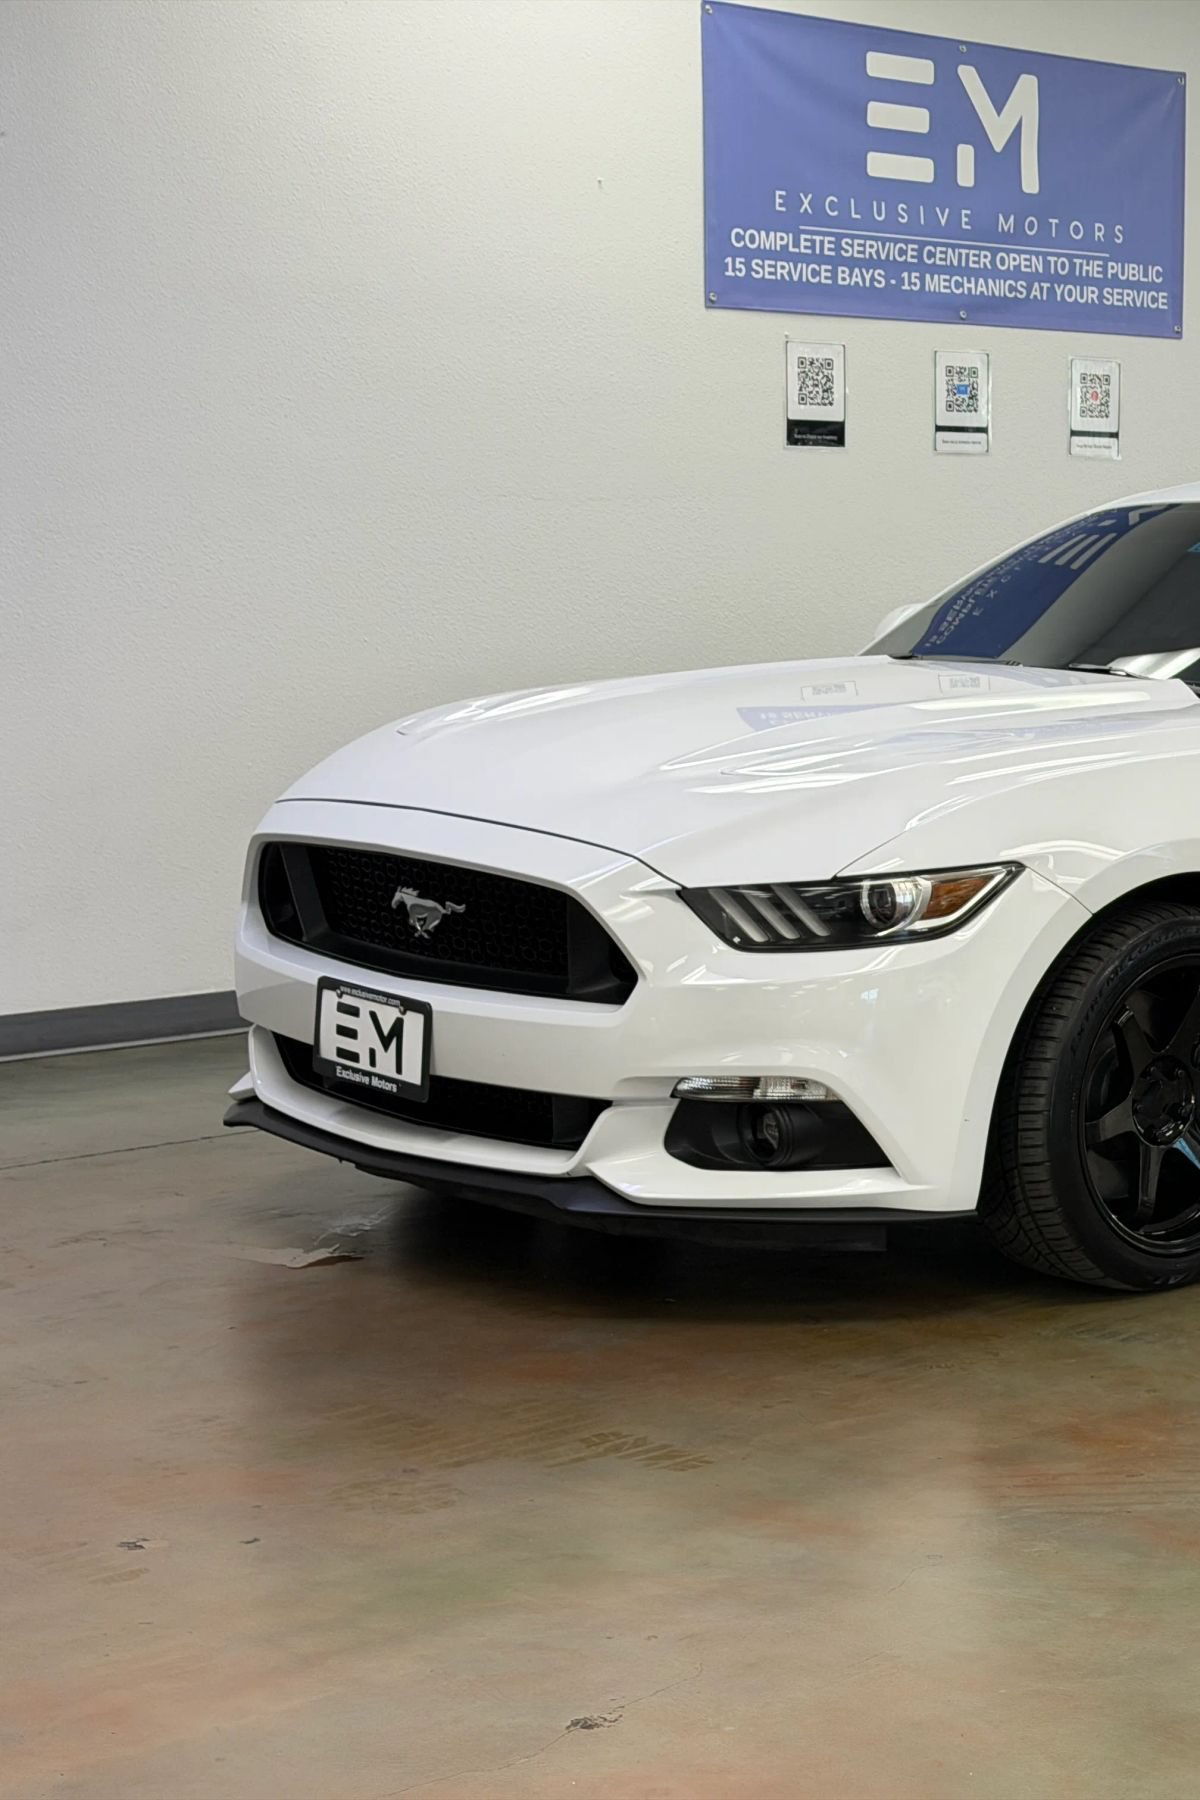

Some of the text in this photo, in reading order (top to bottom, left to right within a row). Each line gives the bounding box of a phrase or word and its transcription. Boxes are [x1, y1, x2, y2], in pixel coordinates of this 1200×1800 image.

[866, 51, 1040, 194] EM
[775, 190, 1124, 244] EXCLUSIVE MOTORS
[724, 256, 746, 277] 15
[751, 258, 833, 284] SERVICE
[837, 266, 886, 288] BAYS
[901, 271, 921, 291] 15
[925, 273, 1027, 299] MECHANICS
[1030, 282, 1051, 300] AT
[1054, 283, 1099, 304] YOUR
[1102, 287, 1168, 309] SERVICE
[731, 227, 1163, 283] COMPLETE SERVICE CENTER OPEN TO THE PUBLIC
[336, 1001, 404, 1075] EM
[335, 1065, 398, 1093] Exclusive Motors
